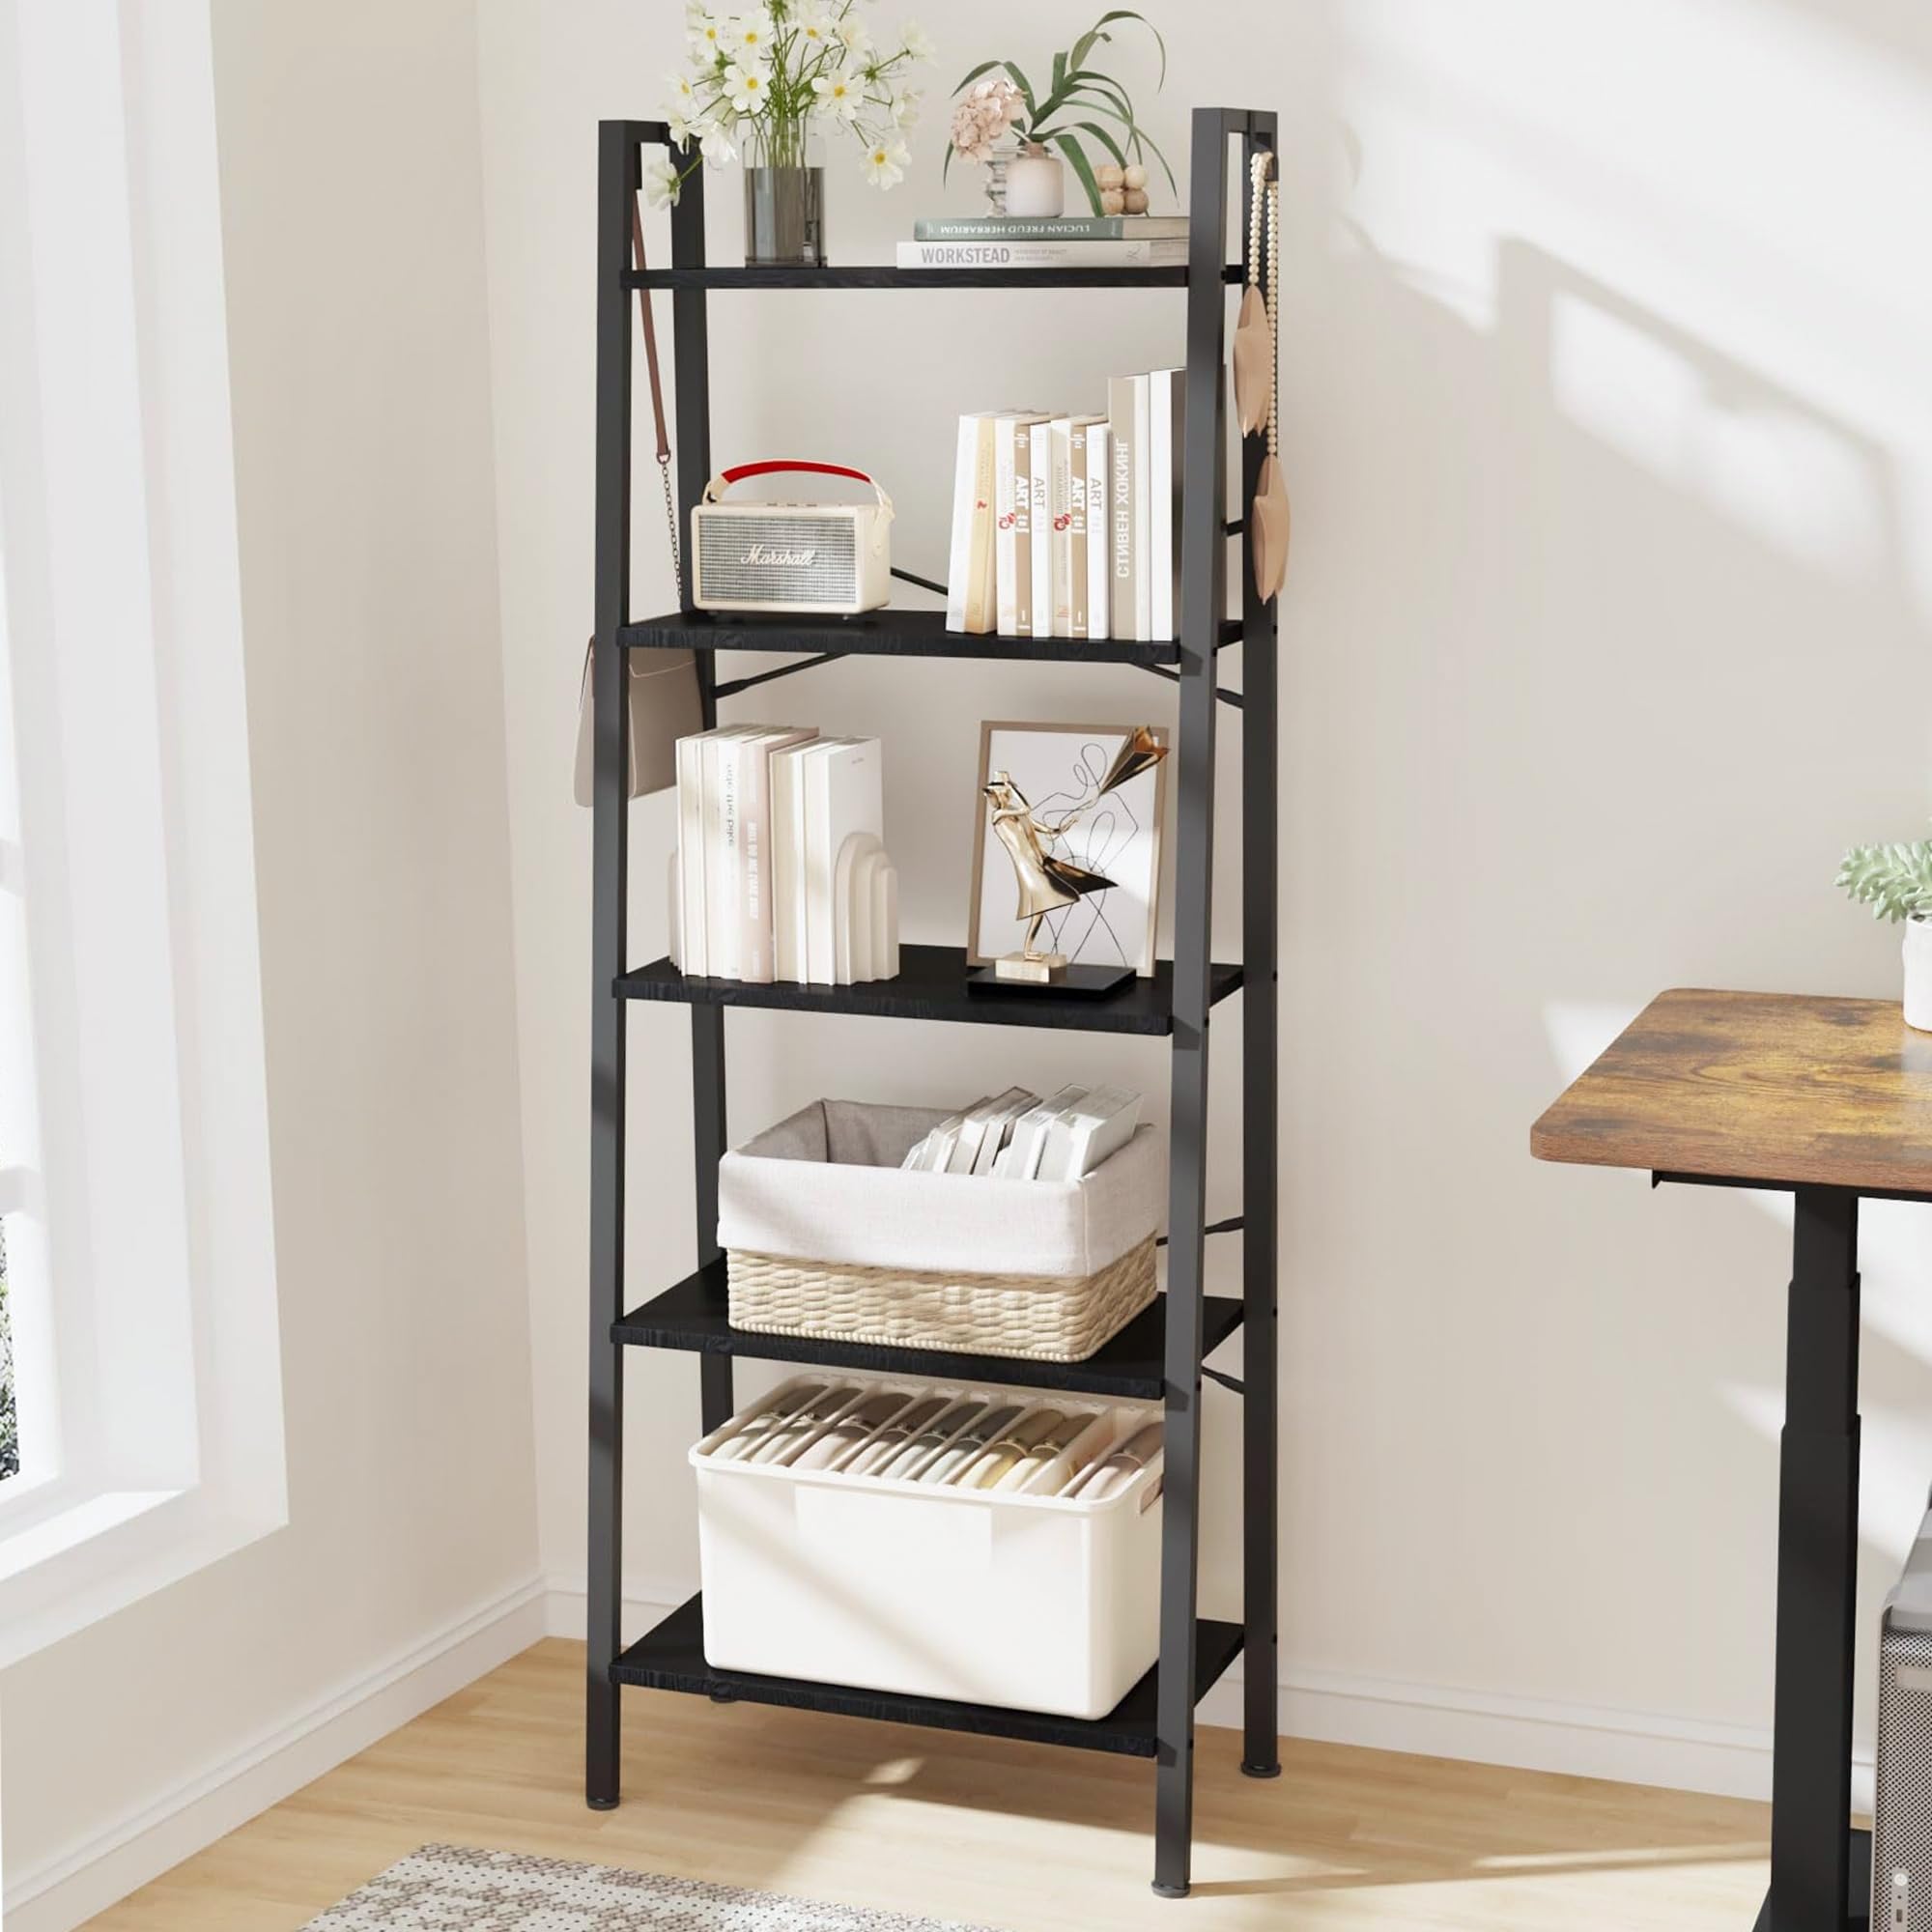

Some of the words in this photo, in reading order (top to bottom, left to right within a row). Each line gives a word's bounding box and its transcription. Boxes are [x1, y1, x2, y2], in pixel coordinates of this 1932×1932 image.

[940, 225, 1006, 234] HERBARIUM
[1008, 225, 1044, 234] FREUD
[1046, 224, 1091, 233] LUCIAN
[921, 247, 1010, 264] WORKSTEAD
[1116, 438, 1129, 504] ХОКИНГ
[1015, 476, 1030, 510] ART
[1034, 477, 1045, 510] ART
[1071, 476, 1086, 511] ART
[1089, 477, 1102, 510] ART
[740, 544, 817, 566] Marshall
[1116, 510, 1129, 579] СТИВЕН
